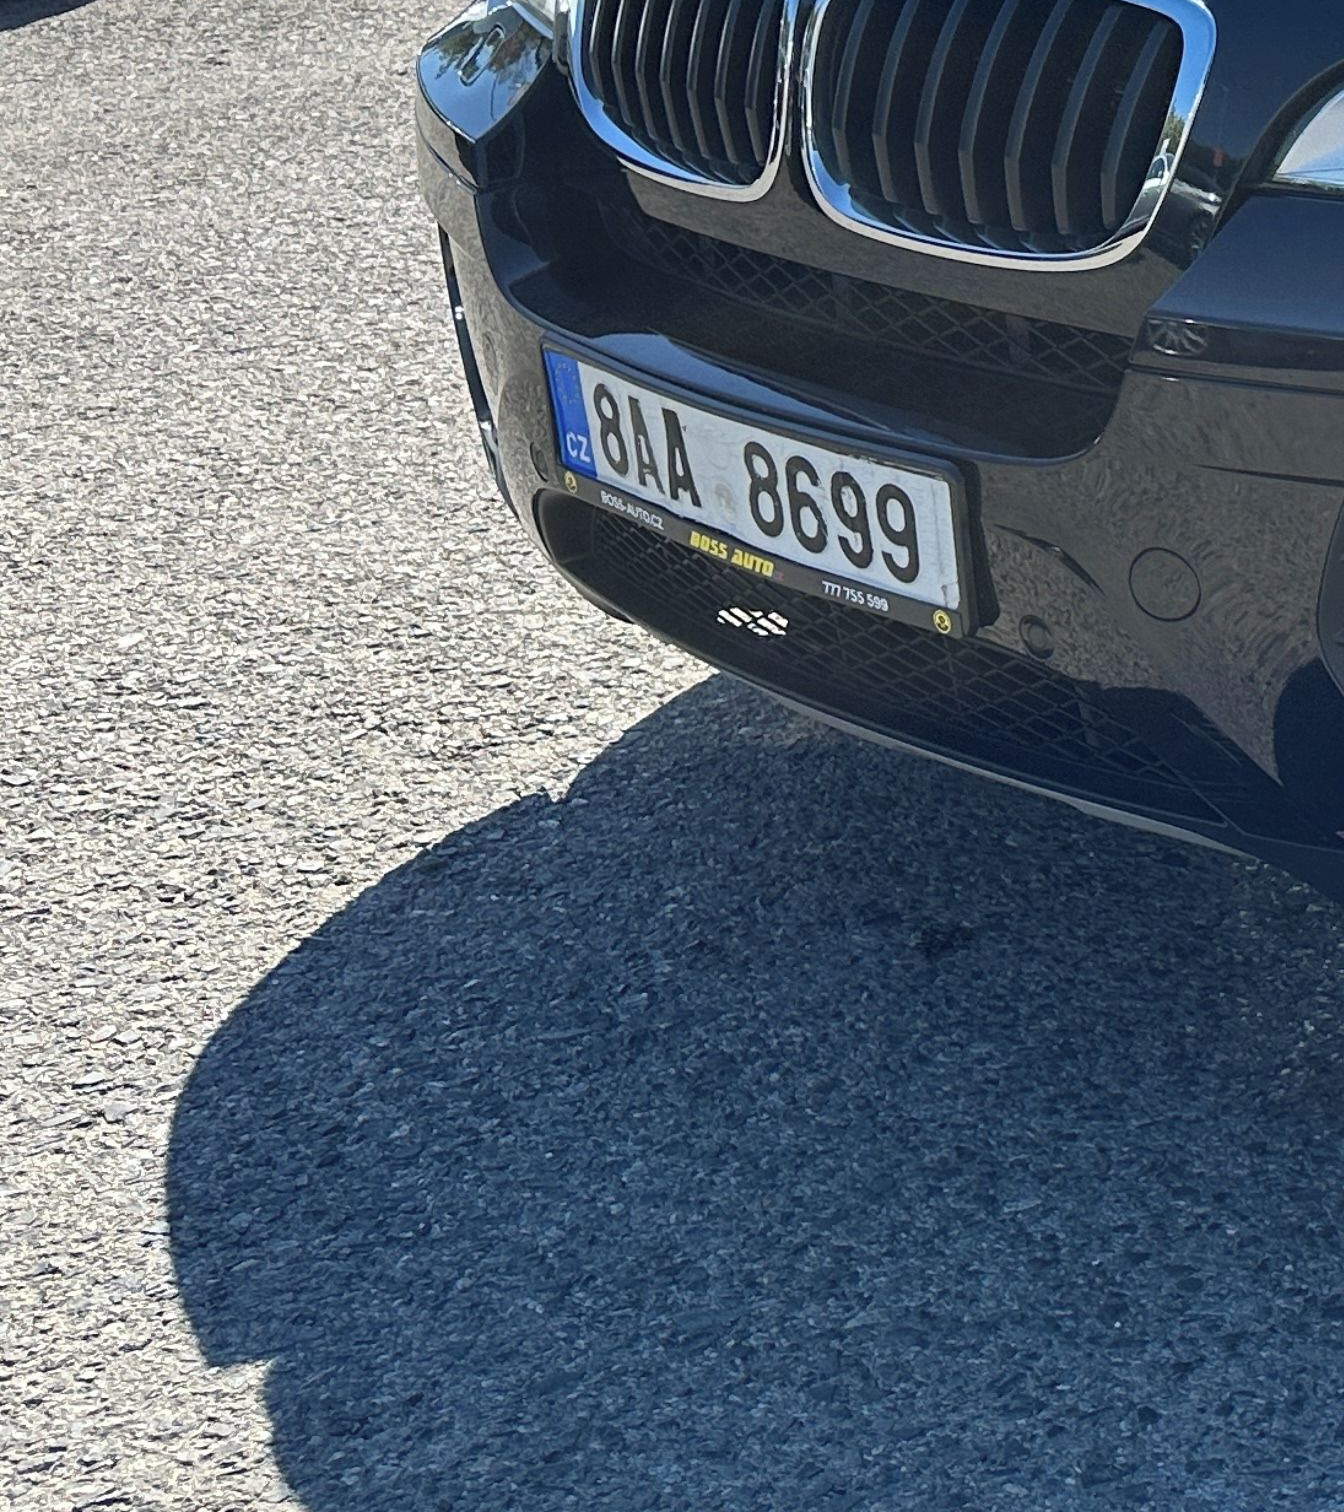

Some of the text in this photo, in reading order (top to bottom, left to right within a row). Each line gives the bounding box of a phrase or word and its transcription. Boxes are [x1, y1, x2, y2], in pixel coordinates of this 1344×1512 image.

[566, 383, 920, 584] CZ 8AA 8699
[690, 530, 728, 560] BOSS
[822, 580, 888, 612] 777 755 599
